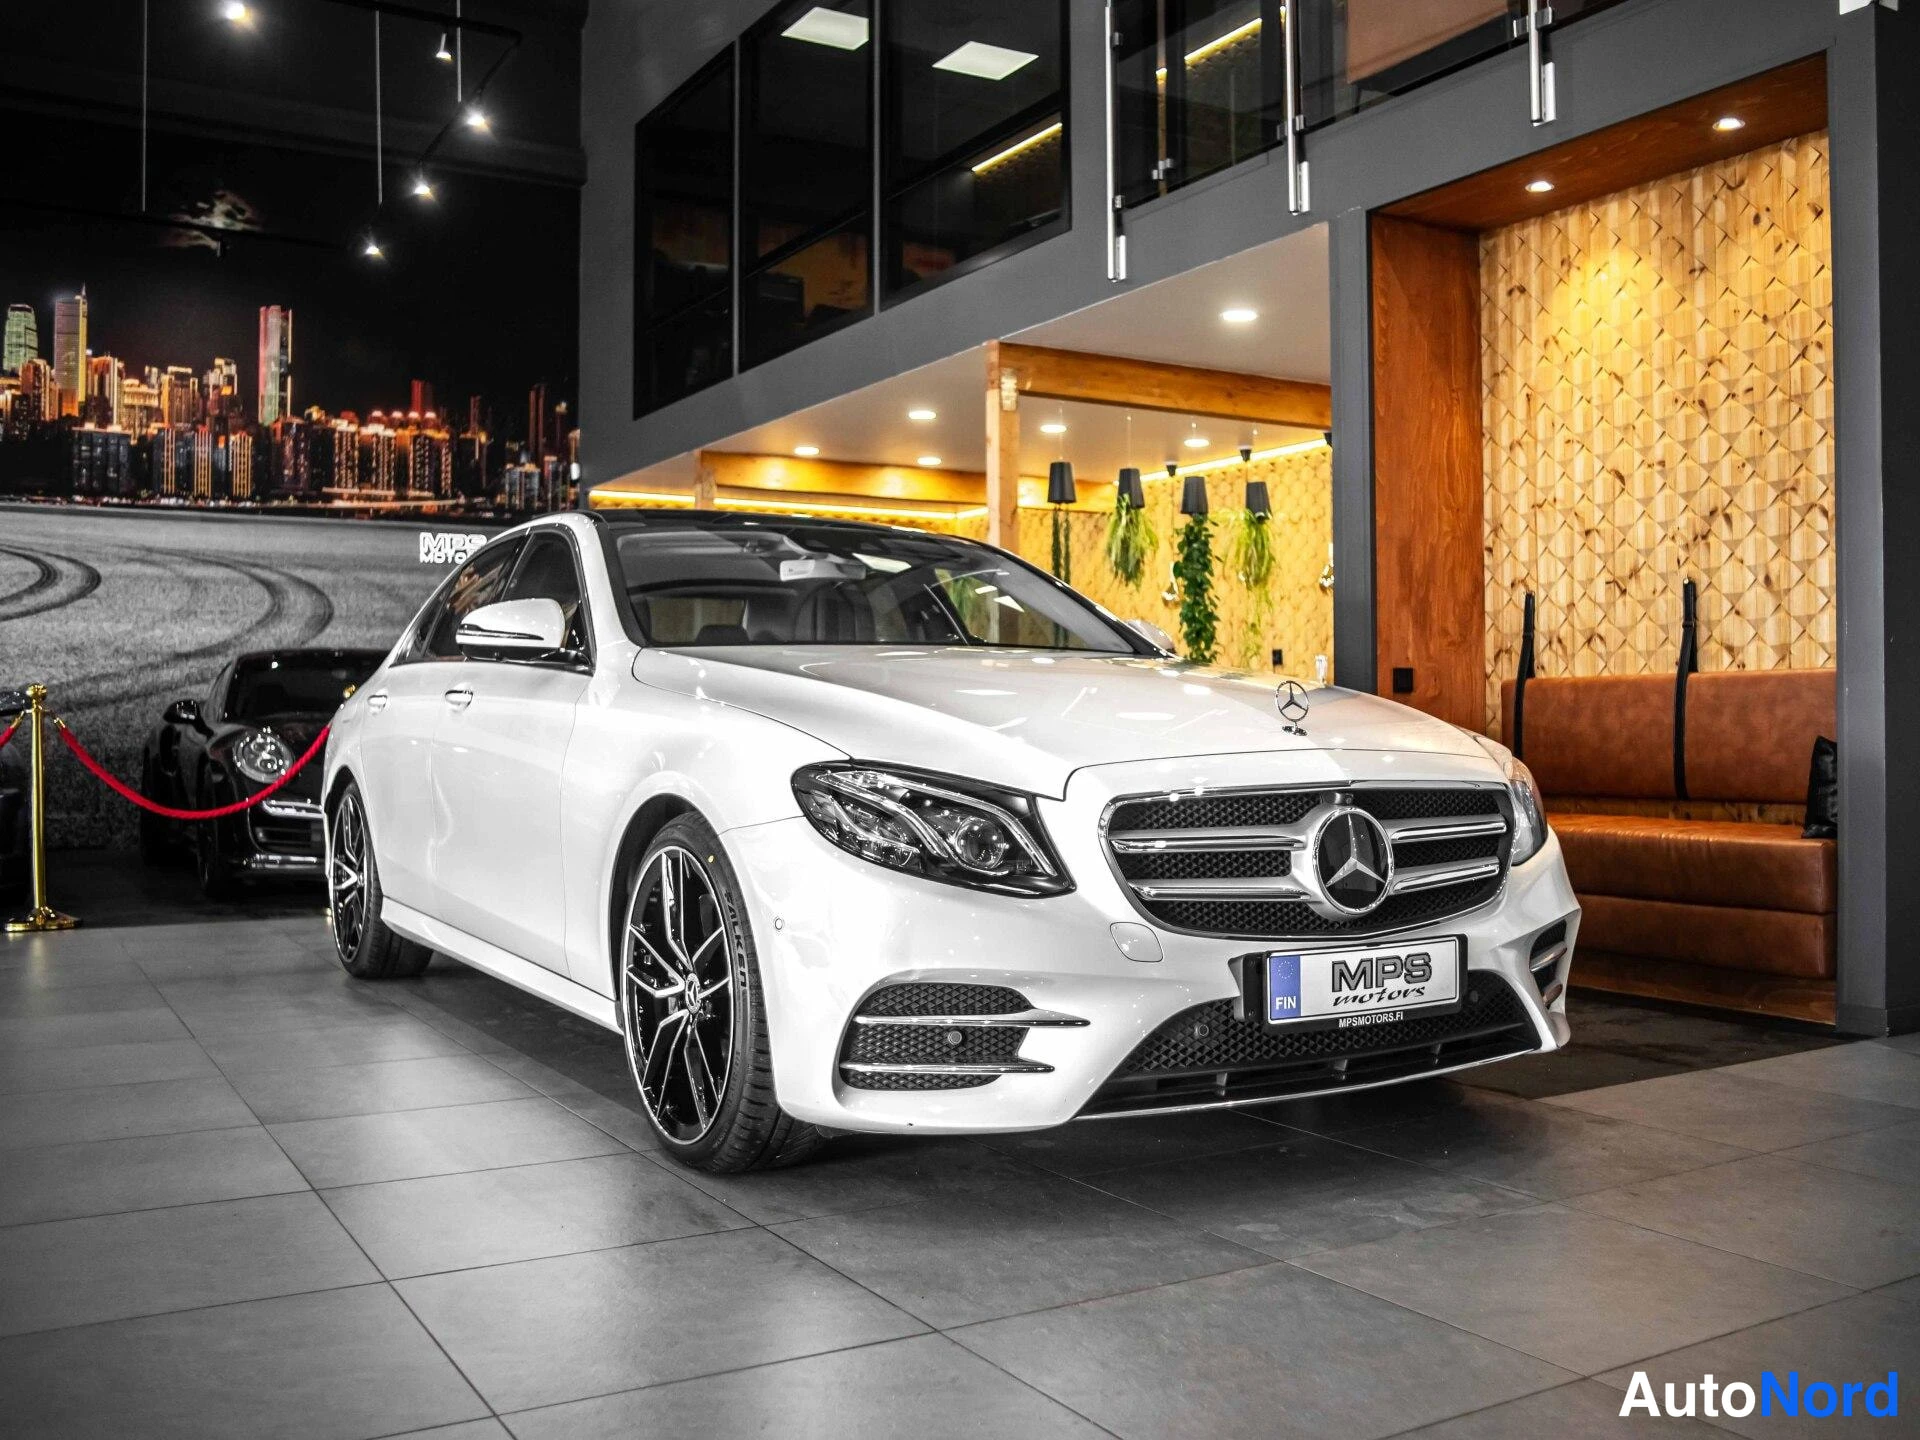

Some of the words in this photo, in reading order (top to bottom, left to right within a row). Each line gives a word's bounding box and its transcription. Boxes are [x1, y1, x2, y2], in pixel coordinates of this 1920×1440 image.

[724, 889, 747, 988] FALKEN
[1331, 952, 1432, 993] MPS
[1275, 995, 1297, 1010] FIN
[1332, 985, 1425, 1007] motors
[1338, 1010, 1404, 1029] MPSMOTORS.FI
